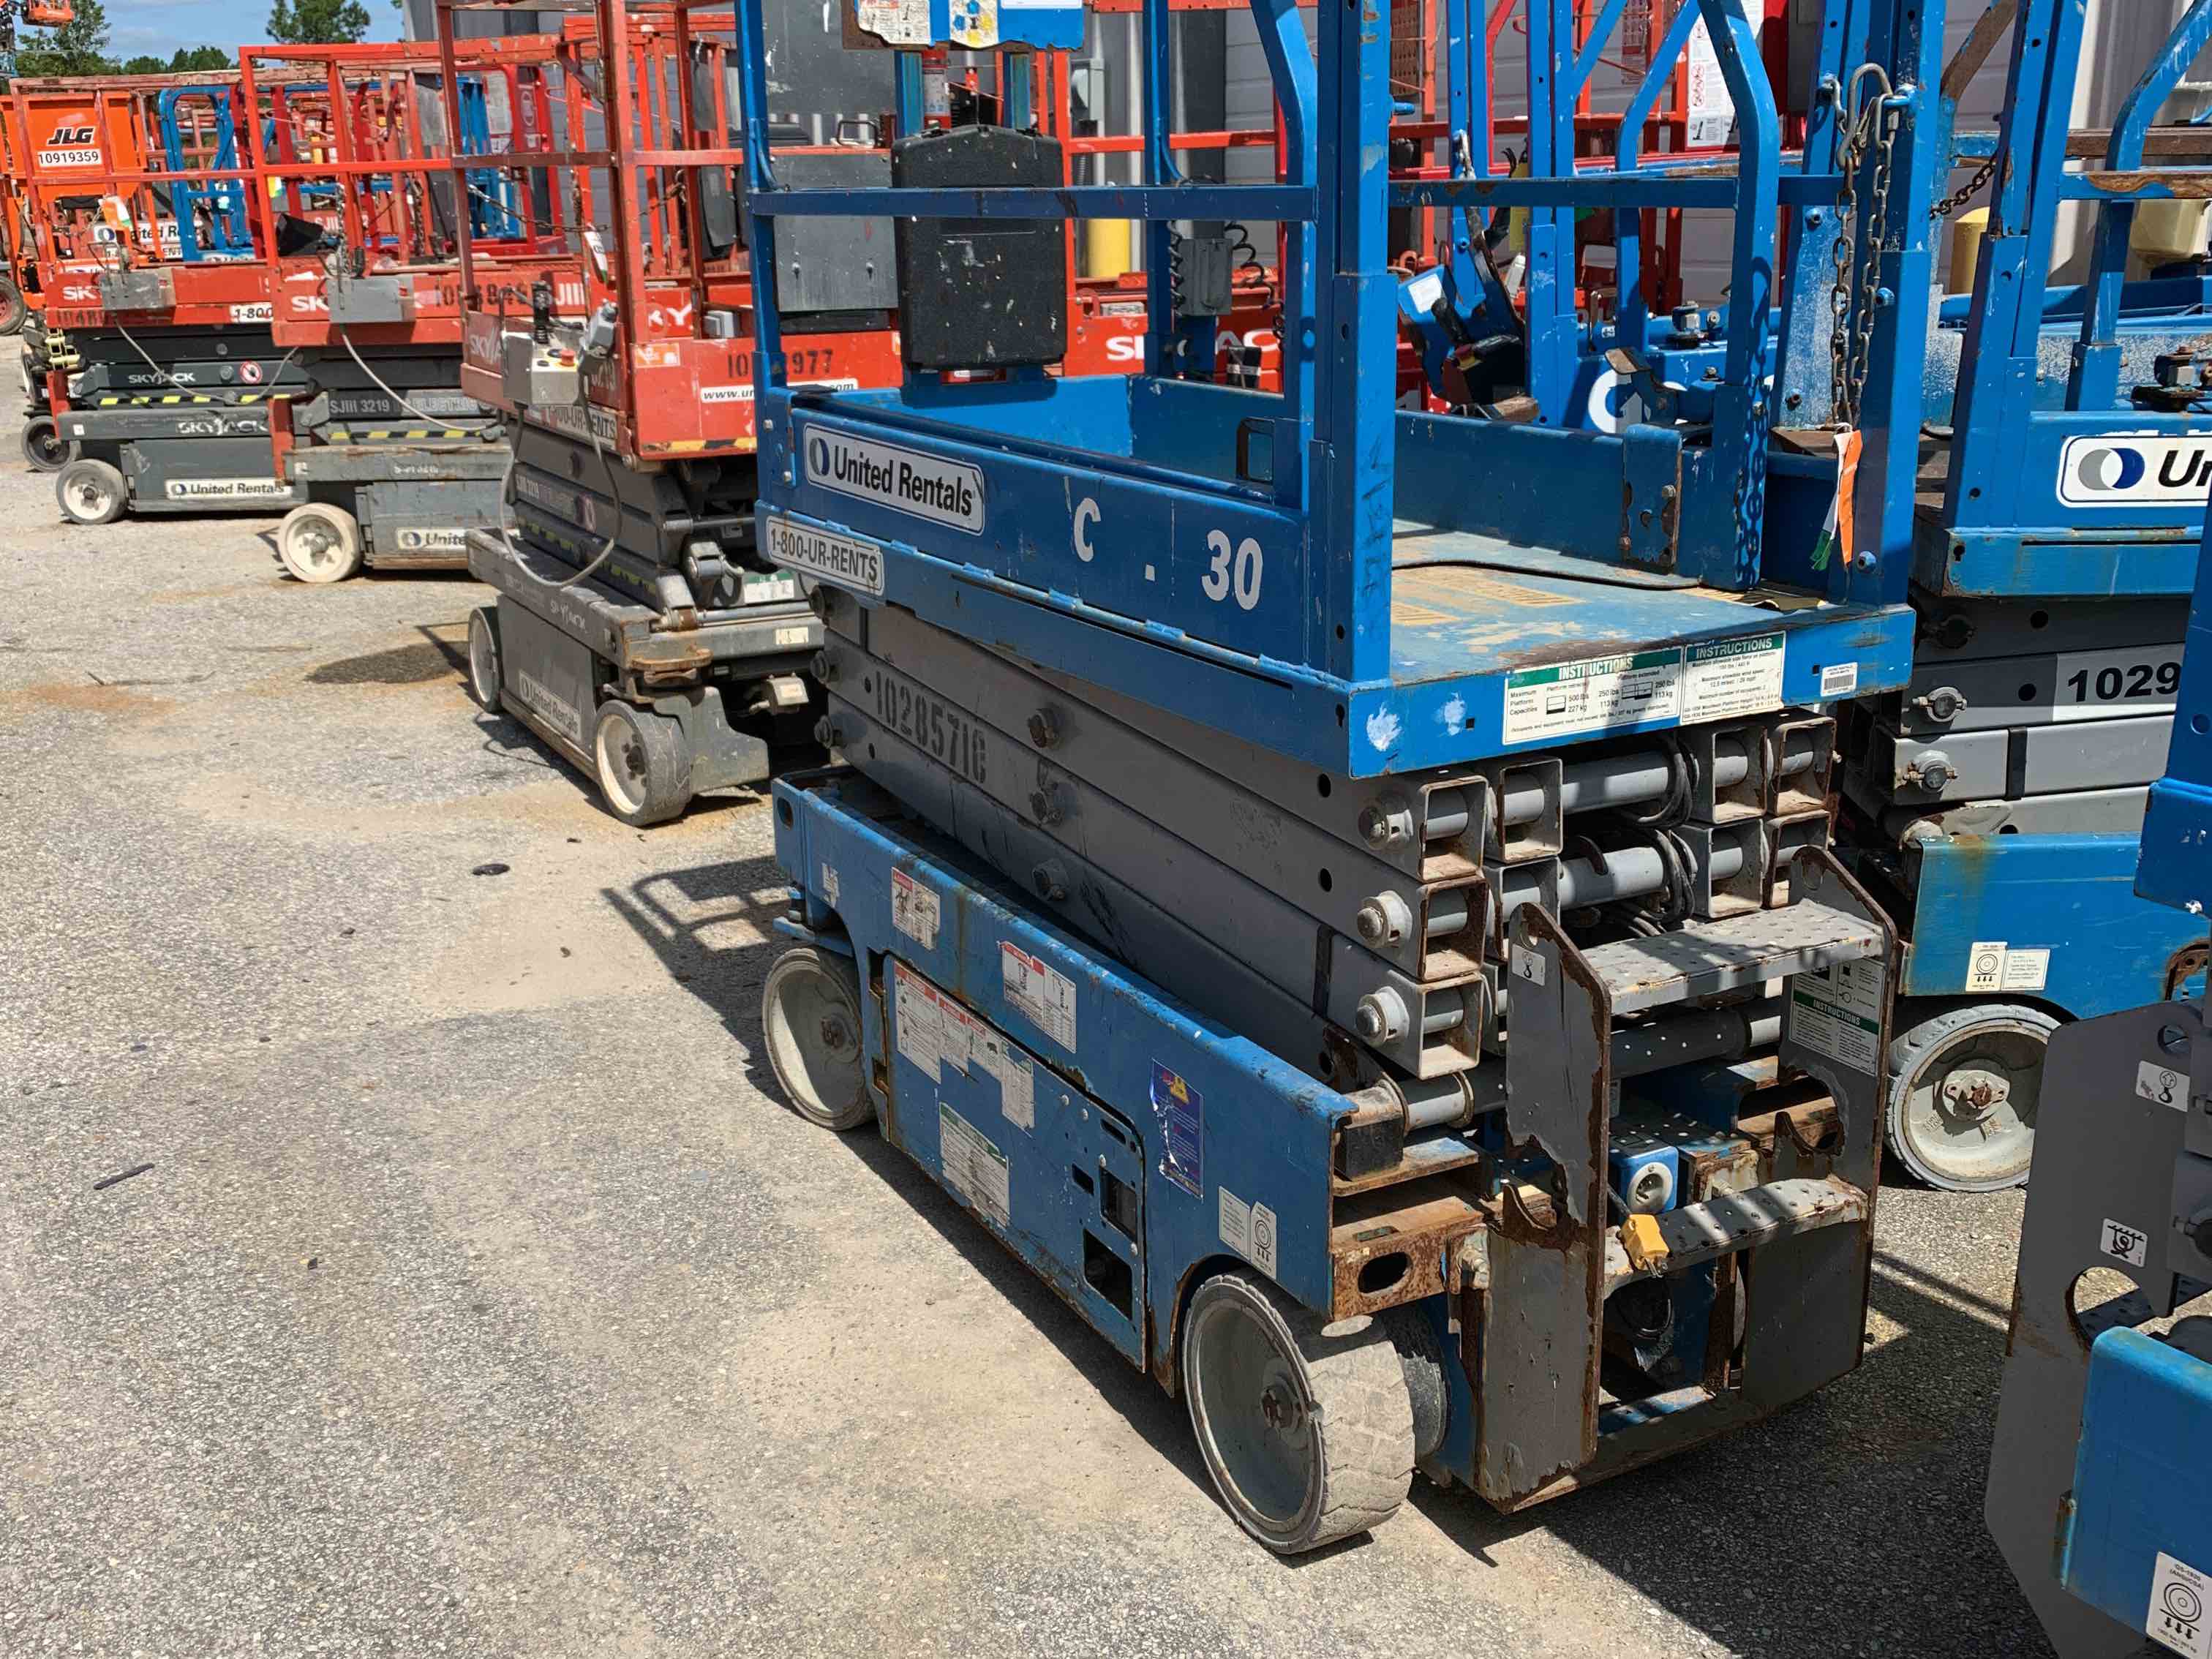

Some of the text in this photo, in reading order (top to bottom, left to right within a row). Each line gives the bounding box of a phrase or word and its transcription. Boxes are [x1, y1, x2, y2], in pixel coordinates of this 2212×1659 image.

[48, 127, 94, 145] JLG
[38, 151, 99, 165] 10919359
[361, 399, 391, 413] 3219
[190, 482, 233, 494] United
[834, 445, 973, 516] United Rentals
[425, 533, 467, 546] Unite
[770, 527, 879, 583] 1-800-UR-RENTS
[1073, 497, 1102, 563] C
[1201, 529, 1264, 611] 30
[1696, 637, 1773, 659] INSTRUCTIONS
[1813, 998, 1862, 1026] INSTRUCTIONS
